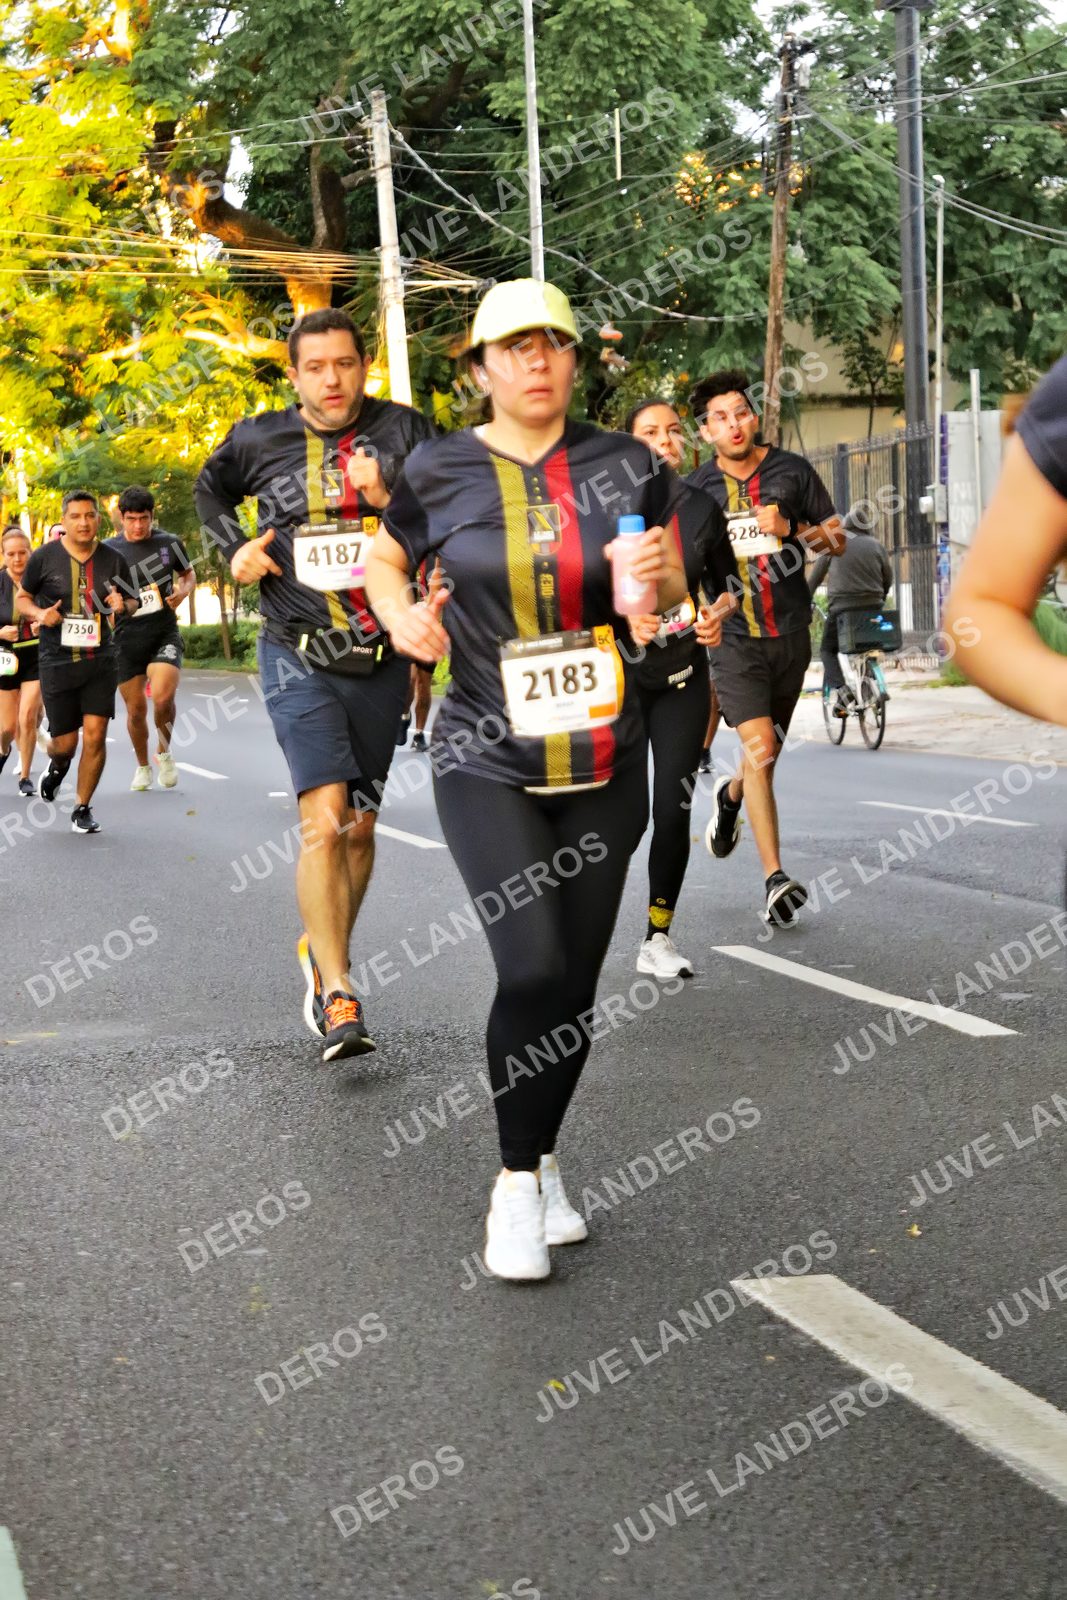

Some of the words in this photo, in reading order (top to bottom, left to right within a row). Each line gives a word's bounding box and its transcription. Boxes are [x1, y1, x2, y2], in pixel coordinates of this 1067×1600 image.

[307, 541, 362, 567] 4187
[67, 624, 94, 635] 7350
[352, 646, 374, 655] SPORT
[521, 660, 599, 701] 2183
